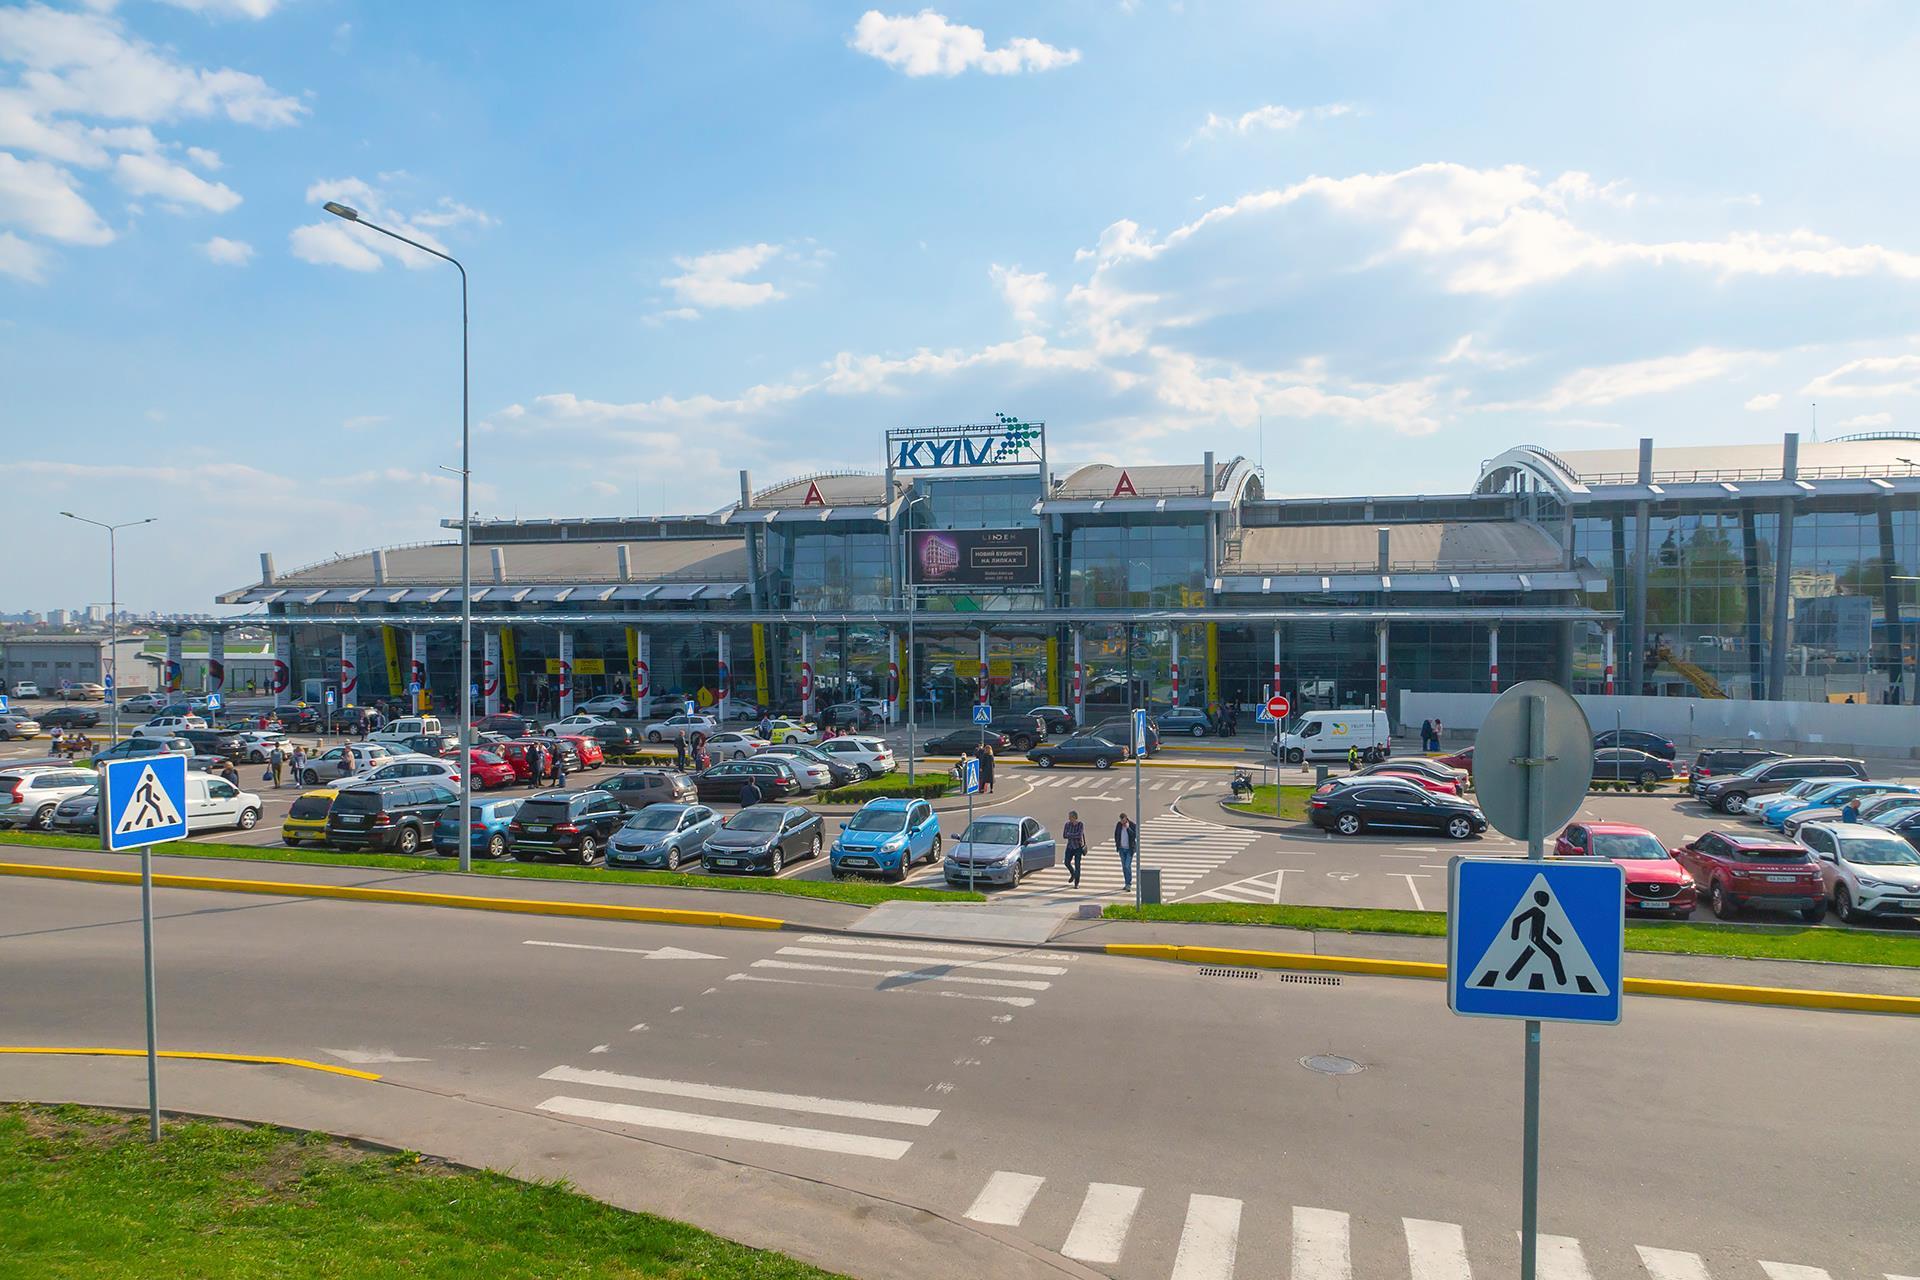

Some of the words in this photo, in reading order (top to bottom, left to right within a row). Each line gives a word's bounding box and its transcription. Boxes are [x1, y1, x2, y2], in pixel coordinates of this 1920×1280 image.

[897, 425, 962, 434] International
[965, 423, 1001, 433] Airport
[900, 438, 995, 467] KYIV
[803, 480, 826, 505] A
[1113, 469, 1137, 496] A
